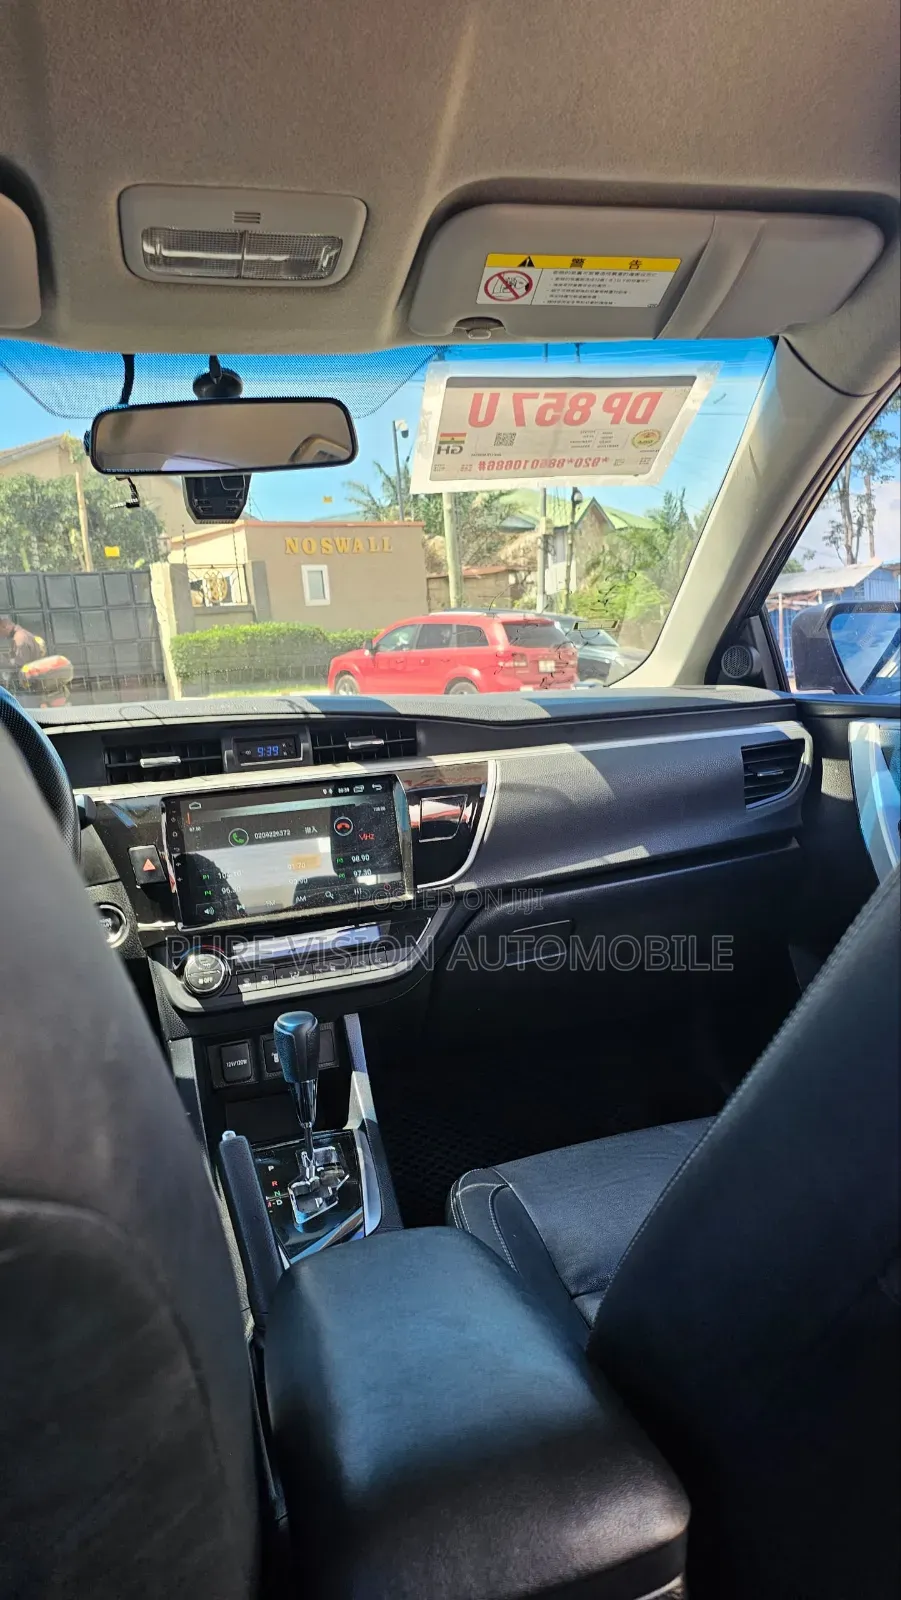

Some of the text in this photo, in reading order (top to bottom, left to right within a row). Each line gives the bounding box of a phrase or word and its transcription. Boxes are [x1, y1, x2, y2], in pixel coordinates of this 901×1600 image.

[284, 536, 393, 555] NOSWALL
[257, 745, 279, 757] 9:39
[351, 854, 370, 863] 98.90
